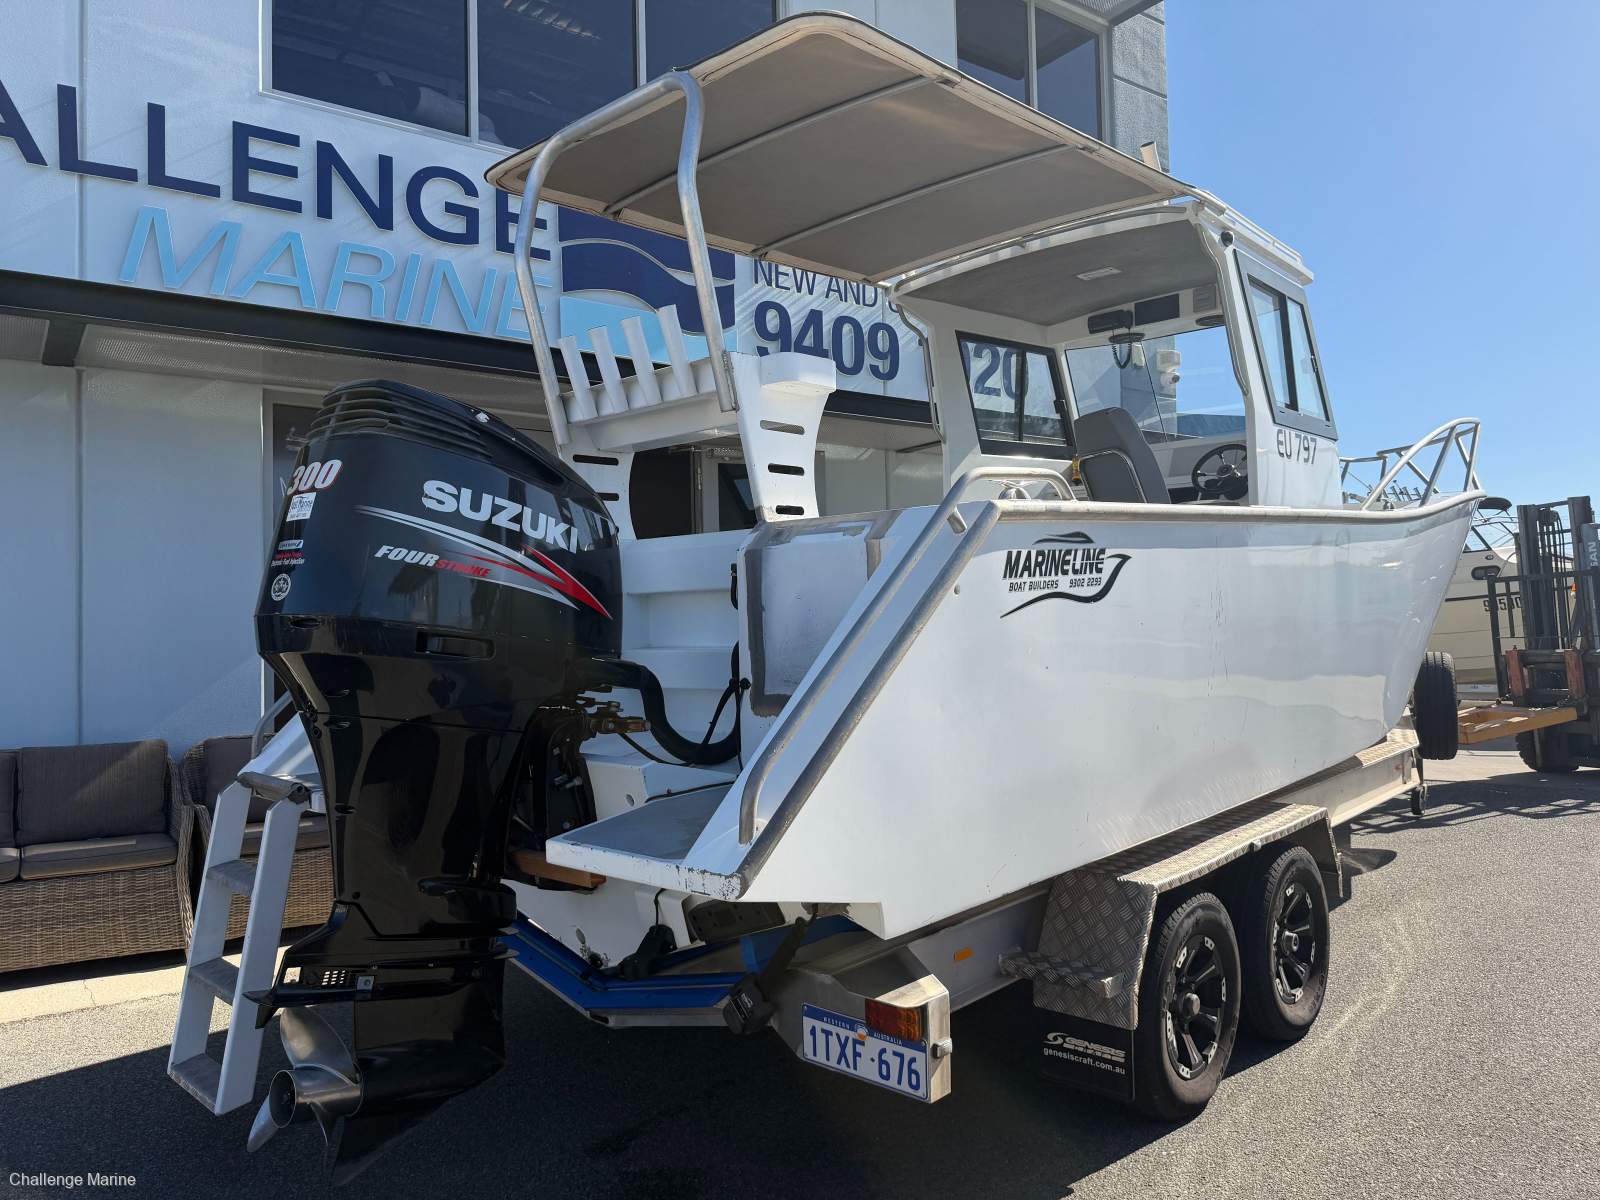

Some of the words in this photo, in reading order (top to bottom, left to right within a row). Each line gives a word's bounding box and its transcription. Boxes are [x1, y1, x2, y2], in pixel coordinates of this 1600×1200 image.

[119, 205, 553, 341] MARINE
[753, 258, 817, 296] NEW
[825, 276, 878, 307] AND
[754, 300, 900, 381] 9409
[1277, 428, 1292, 460] EU
[1295, 432, 1317, 465] 797
[287, 459, 343, 495] 300
[421, 479, 578, 554] SUZUKI
[1009, 581, 1026, 592] BOAT
[1028, 579, 1059, 590] BUILDERS
[1069, 577, 1085, 588] 9302
[1086, 576, 1102, 587] 2293
[823, 1016, 850, 1029] WESTERN
[873, 1031, 902, 1046] AUSTRALIA
[1065, 1036, 1126, 1058] GENESIS
[1043, 1047, 1126, 1075] genesiscraft.com.au
